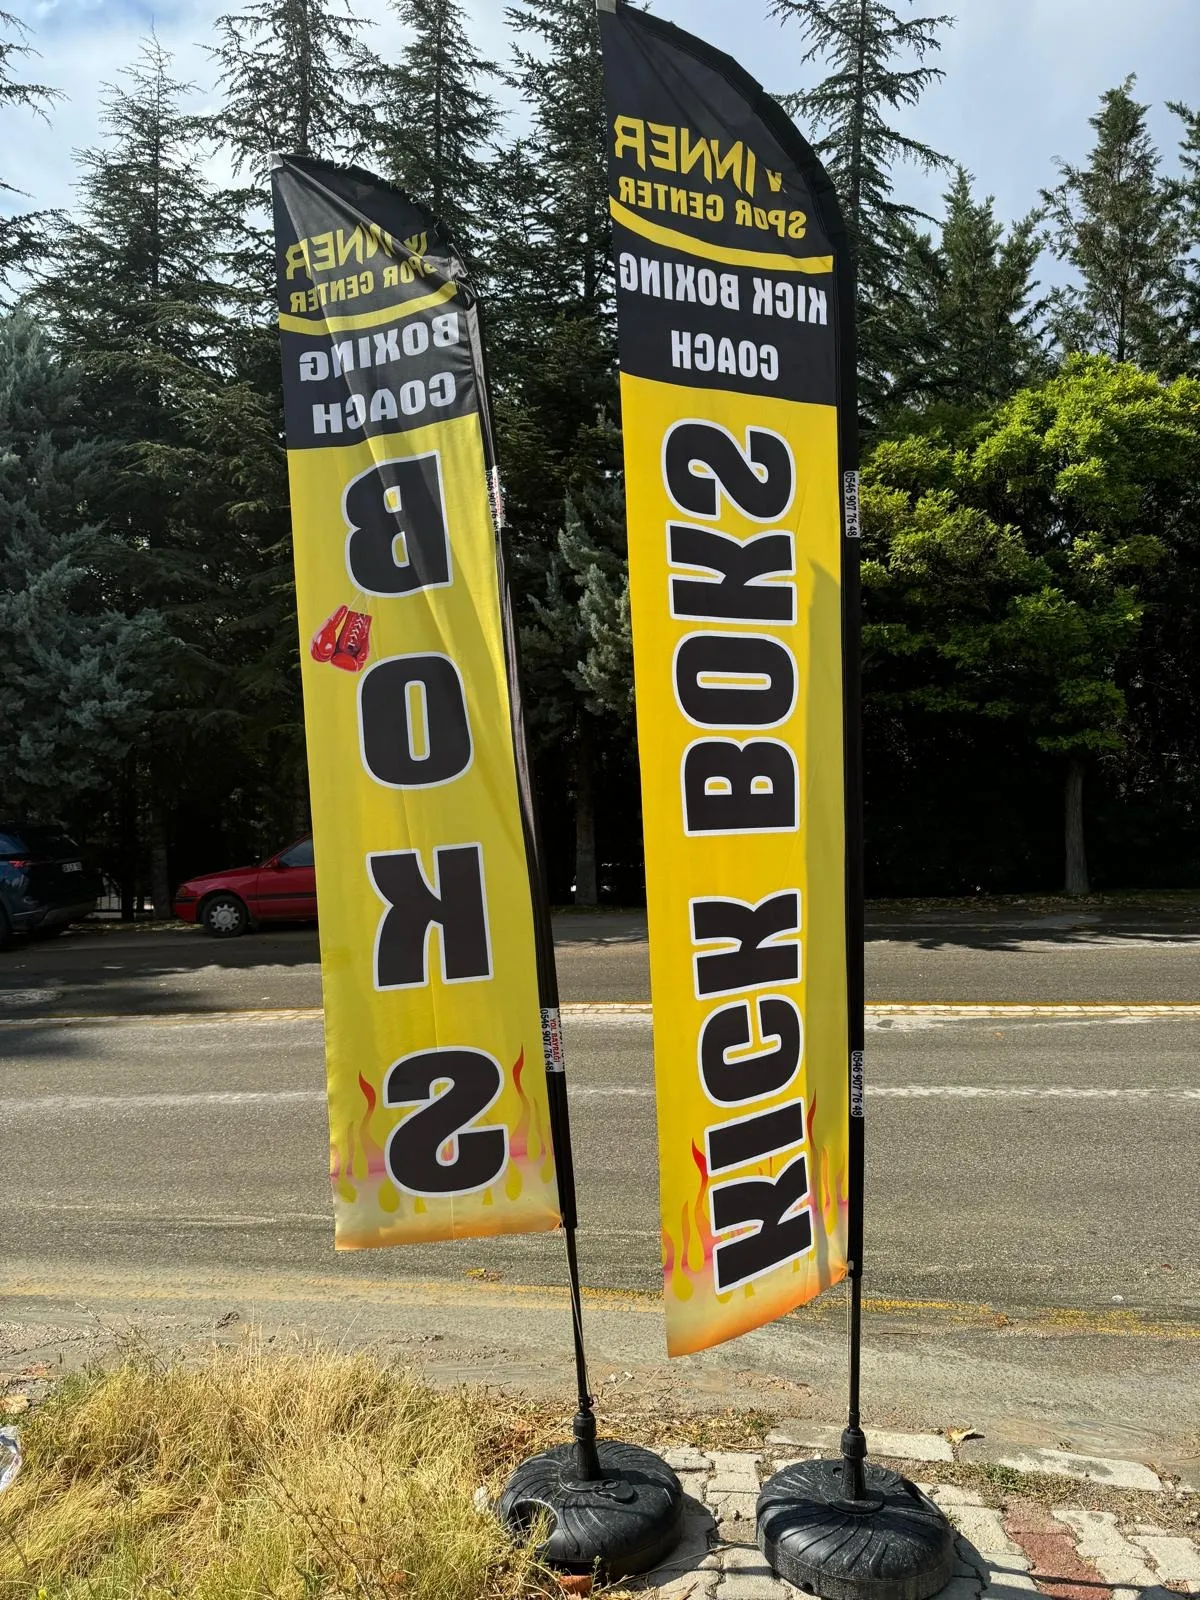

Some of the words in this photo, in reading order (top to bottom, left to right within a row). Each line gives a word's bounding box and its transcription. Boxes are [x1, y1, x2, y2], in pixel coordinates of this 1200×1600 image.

[845, 472, 856, 493] 0546
[846, 496, 857, 511] 907
[847, 513, 857, 524] 76
[847, 526, 858, 537] 48
[540, 1009, 550, 1029] 0546
[550, 1018, 558, 1031] YOL
[542, 1030, 551, 1046] 907
[544, 1048, 553, 1059] 76
[545, 1061, 554, 1071] 48
[852, 1051, 863, 1072] 0546
[852, 1074, 863, 1090] 907
[852, 1093, 863, 1103] 76
[852, 1105, 863, 1116] 48
